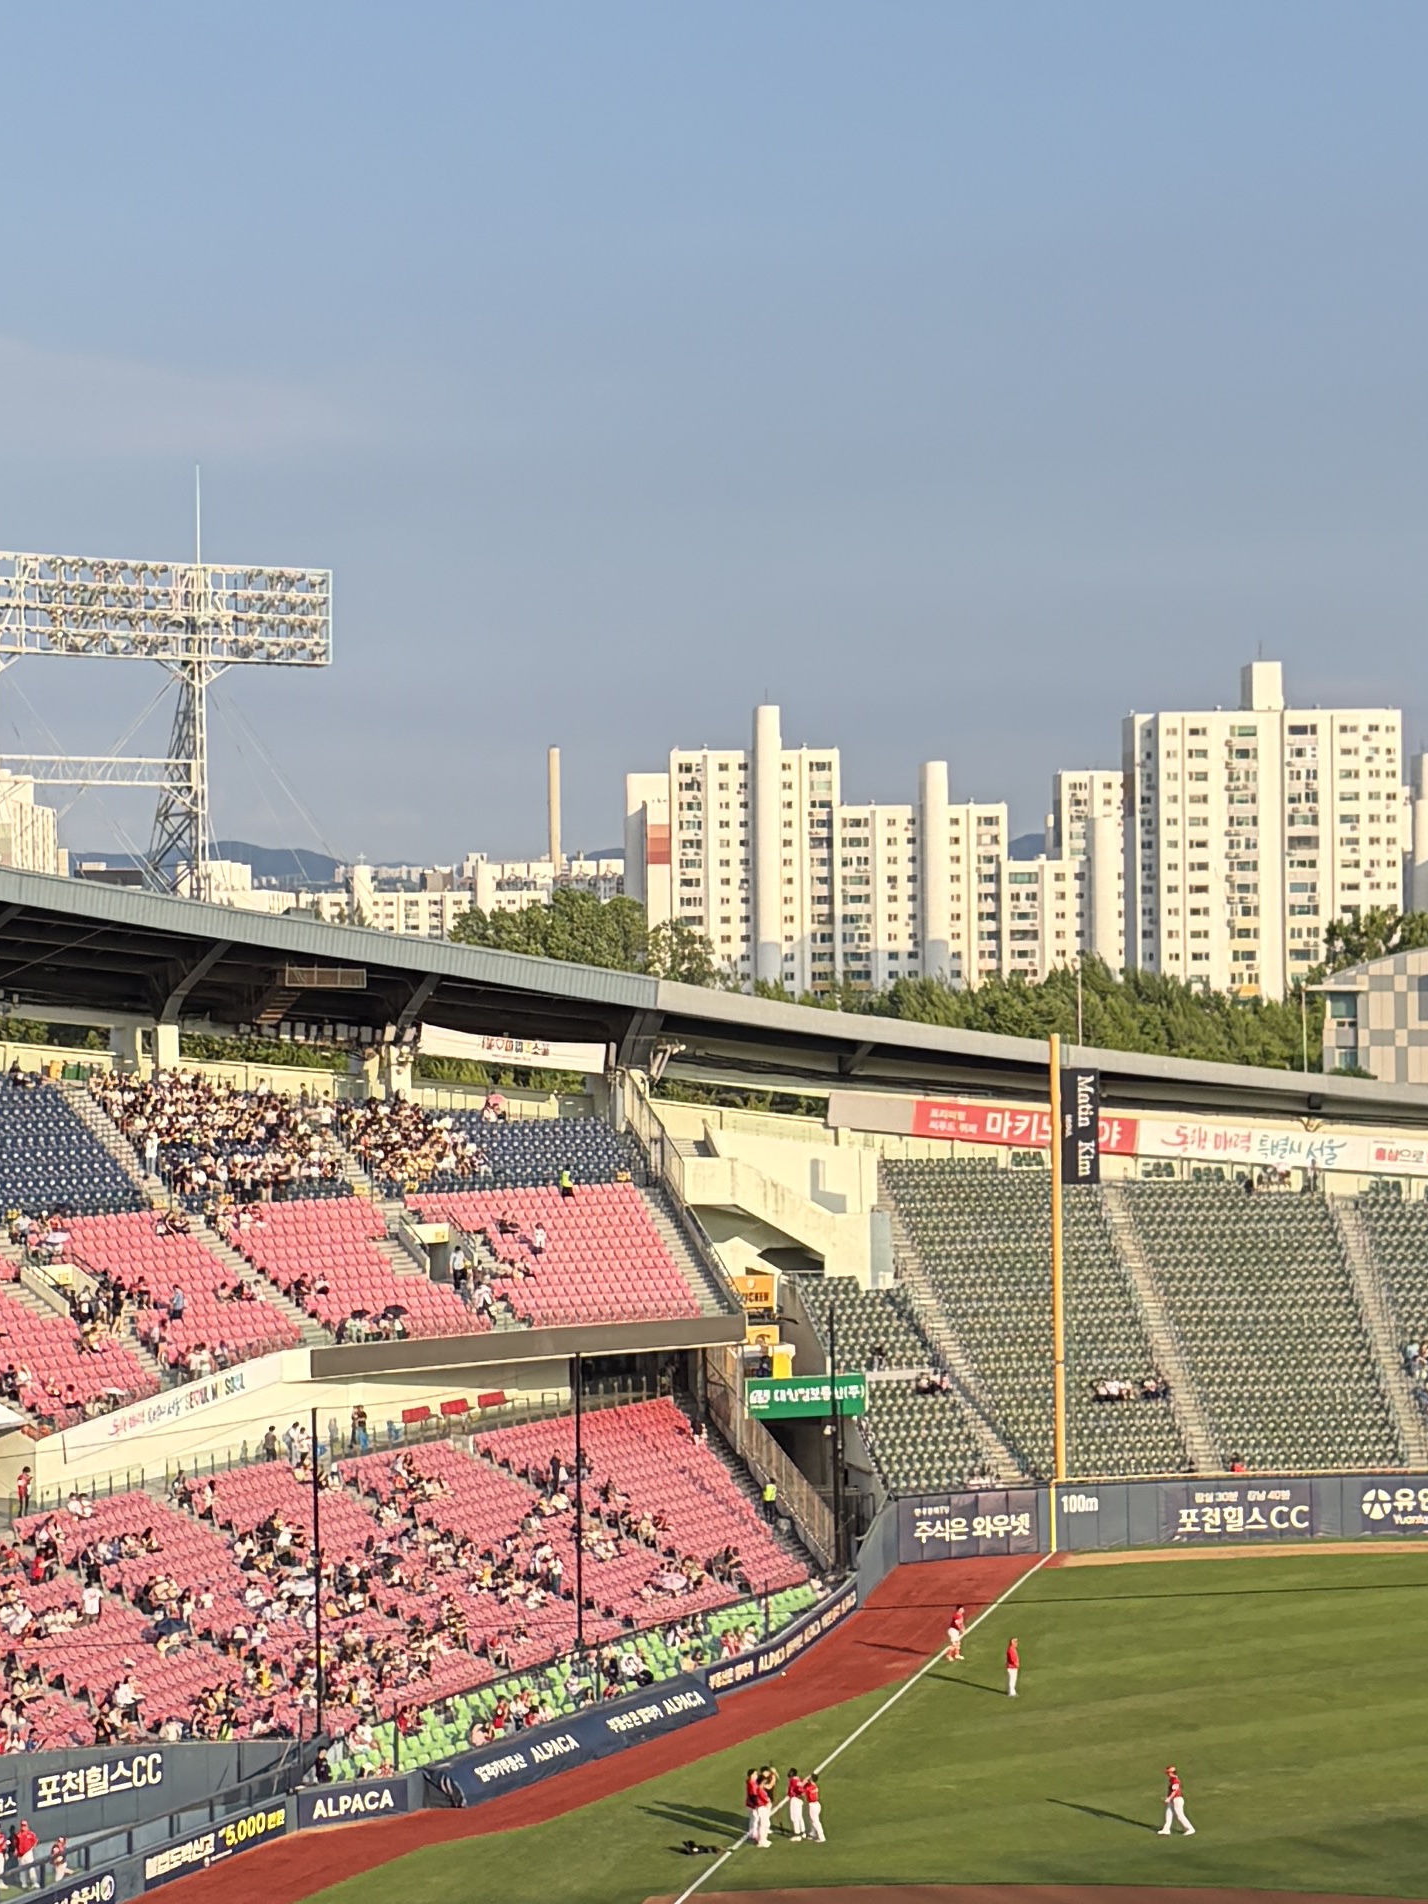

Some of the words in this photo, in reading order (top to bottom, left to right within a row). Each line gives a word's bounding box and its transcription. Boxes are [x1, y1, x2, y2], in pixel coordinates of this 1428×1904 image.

[1077, 1074, 1095, 1128] Matin
[1077, 1139, 1096, 1178] Kim
[1061, 1494, 1099, 1513] 100m
[1177, 1505, 1310, 1533] 포천힐스CC
[913, 1517, 969, 1543] 주식은
[972, 1512, 1030, 1538] 와우넷
[530, 1733, 580, 1764] ALPACA
[36, 1752, 163, 1808] 포천힐스CC
[313, 1789, 395, 1820] ALPACA
